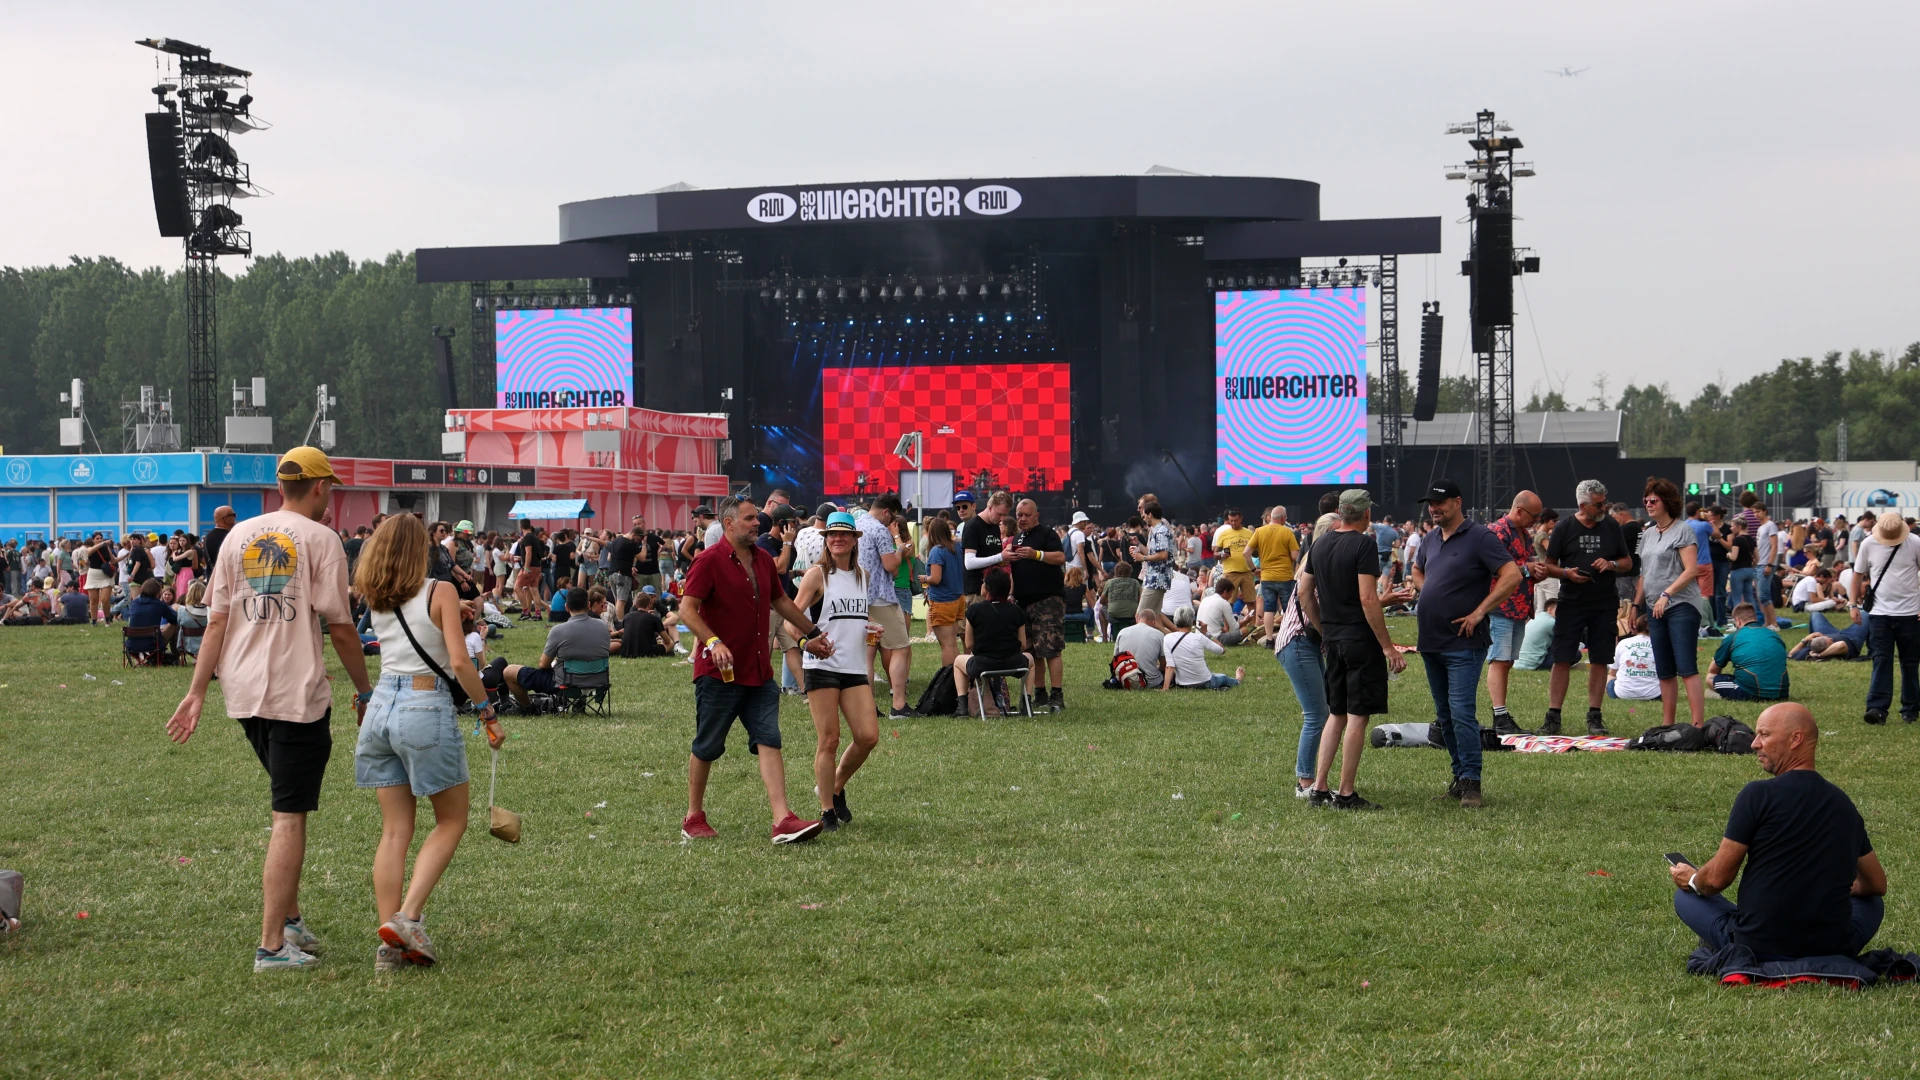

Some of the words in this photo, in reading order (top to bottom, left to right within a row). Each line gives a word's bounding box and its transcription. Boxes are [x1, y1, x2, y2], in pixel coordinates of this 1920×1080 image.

[759, 198, 784, 217] RW
[978, 190, 1007, 210] RW
[240, 532, 257, 550] OFF
[283, 526, 301, 546] WALL
[243, 595, 297, 622] VANS
